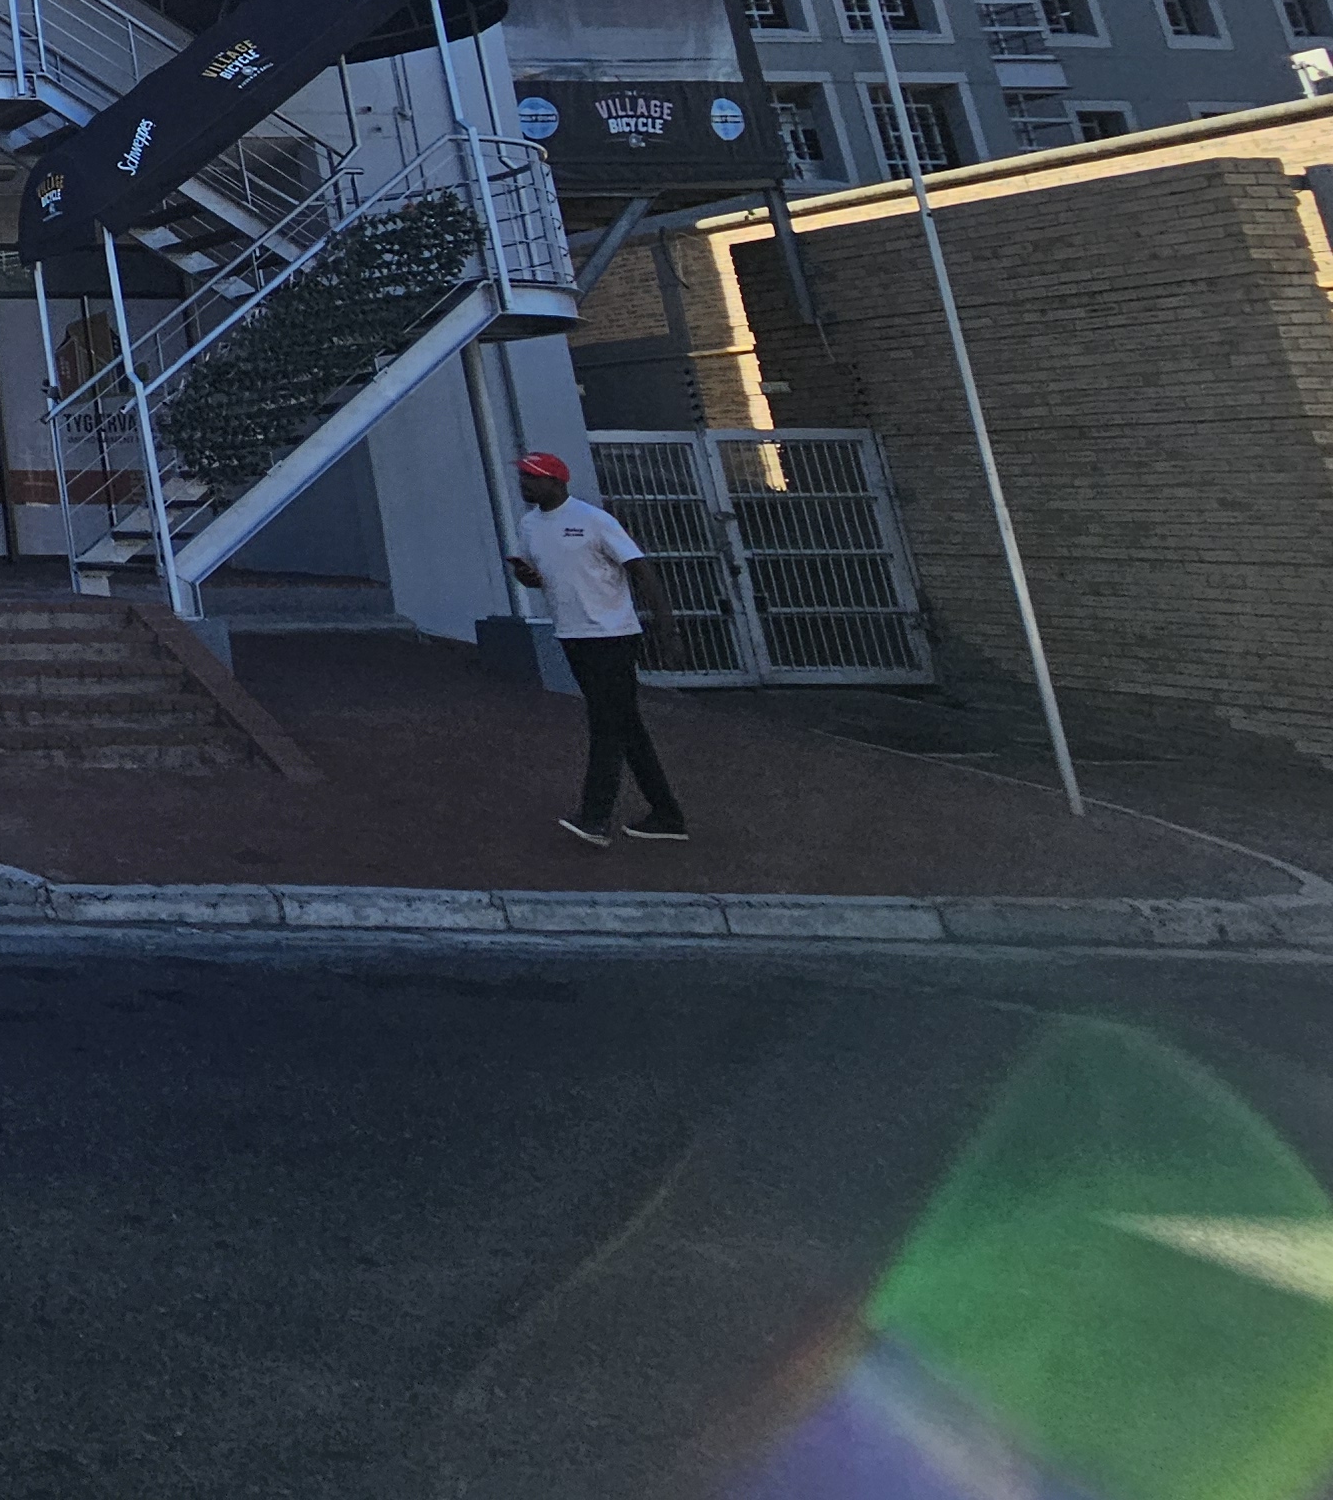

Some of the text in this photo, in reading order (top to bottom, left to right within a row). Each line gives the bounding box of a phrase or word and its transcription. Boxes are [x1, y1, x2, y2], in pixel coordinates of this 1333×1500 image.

[201, 39, 258, 78] VILLAGE
[219, 49, 260, 80] BICYCLE
[595, 98, 674, 120] VILLAGE
[608, 118, 664, 134] BICYCLE
[117, 118, 153, 176] Schweppes
